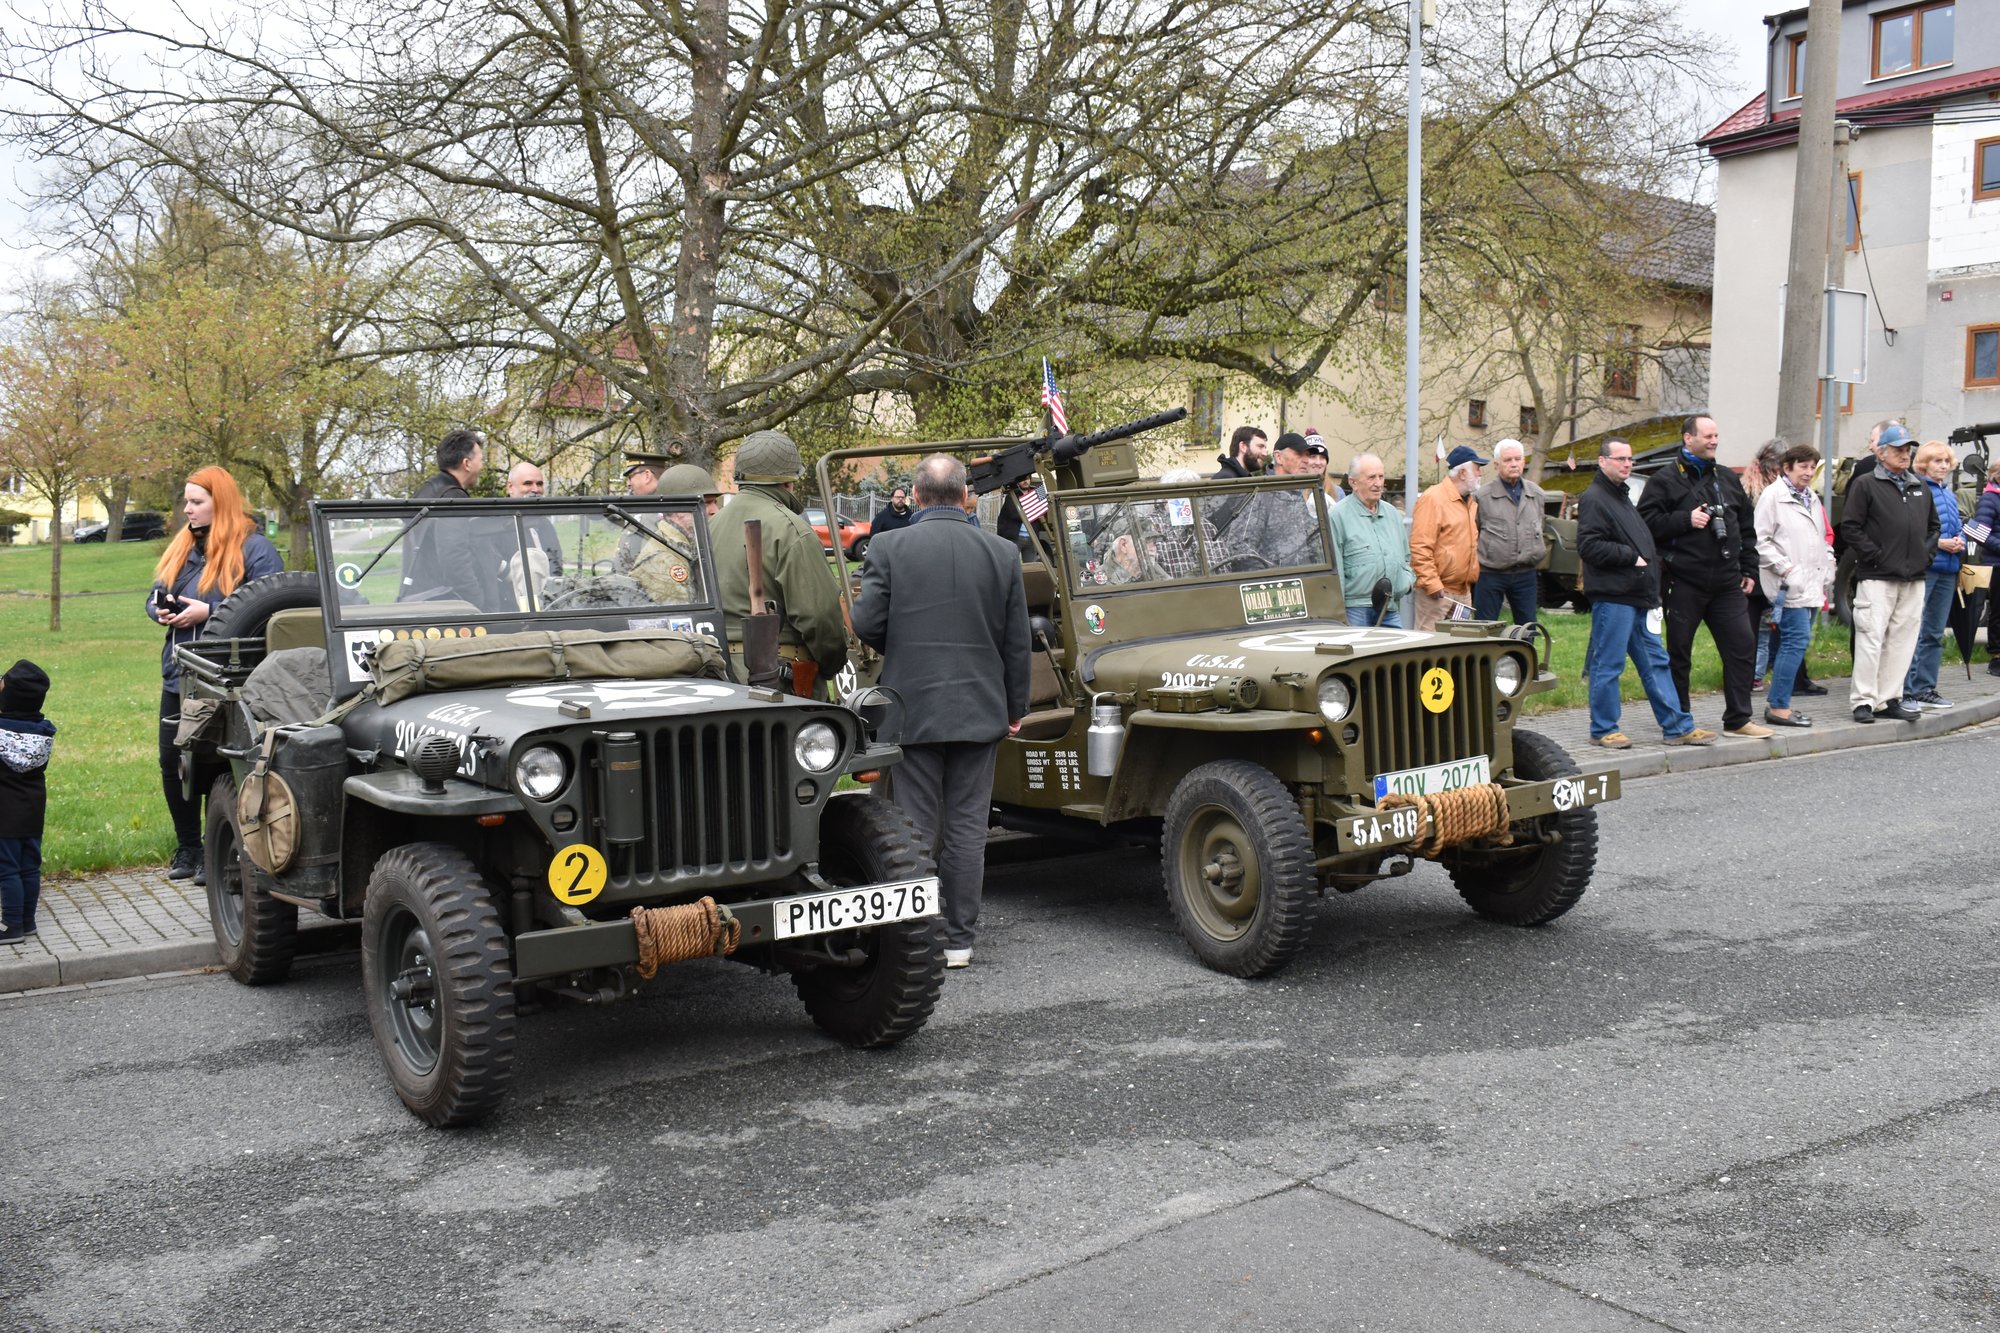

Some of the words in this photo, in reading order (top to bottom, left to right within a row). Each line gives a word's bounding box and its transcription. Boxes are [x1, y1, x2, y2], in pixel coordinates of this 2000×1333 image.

[1245, 591, 1273, 611] OMAHA
[1276, 588, 1303, 607] BEACH
[1431, 676, 1444, 701] 2
[1441, 761, 1481, 792] 2071
[565, 851, 592, 898] 2
